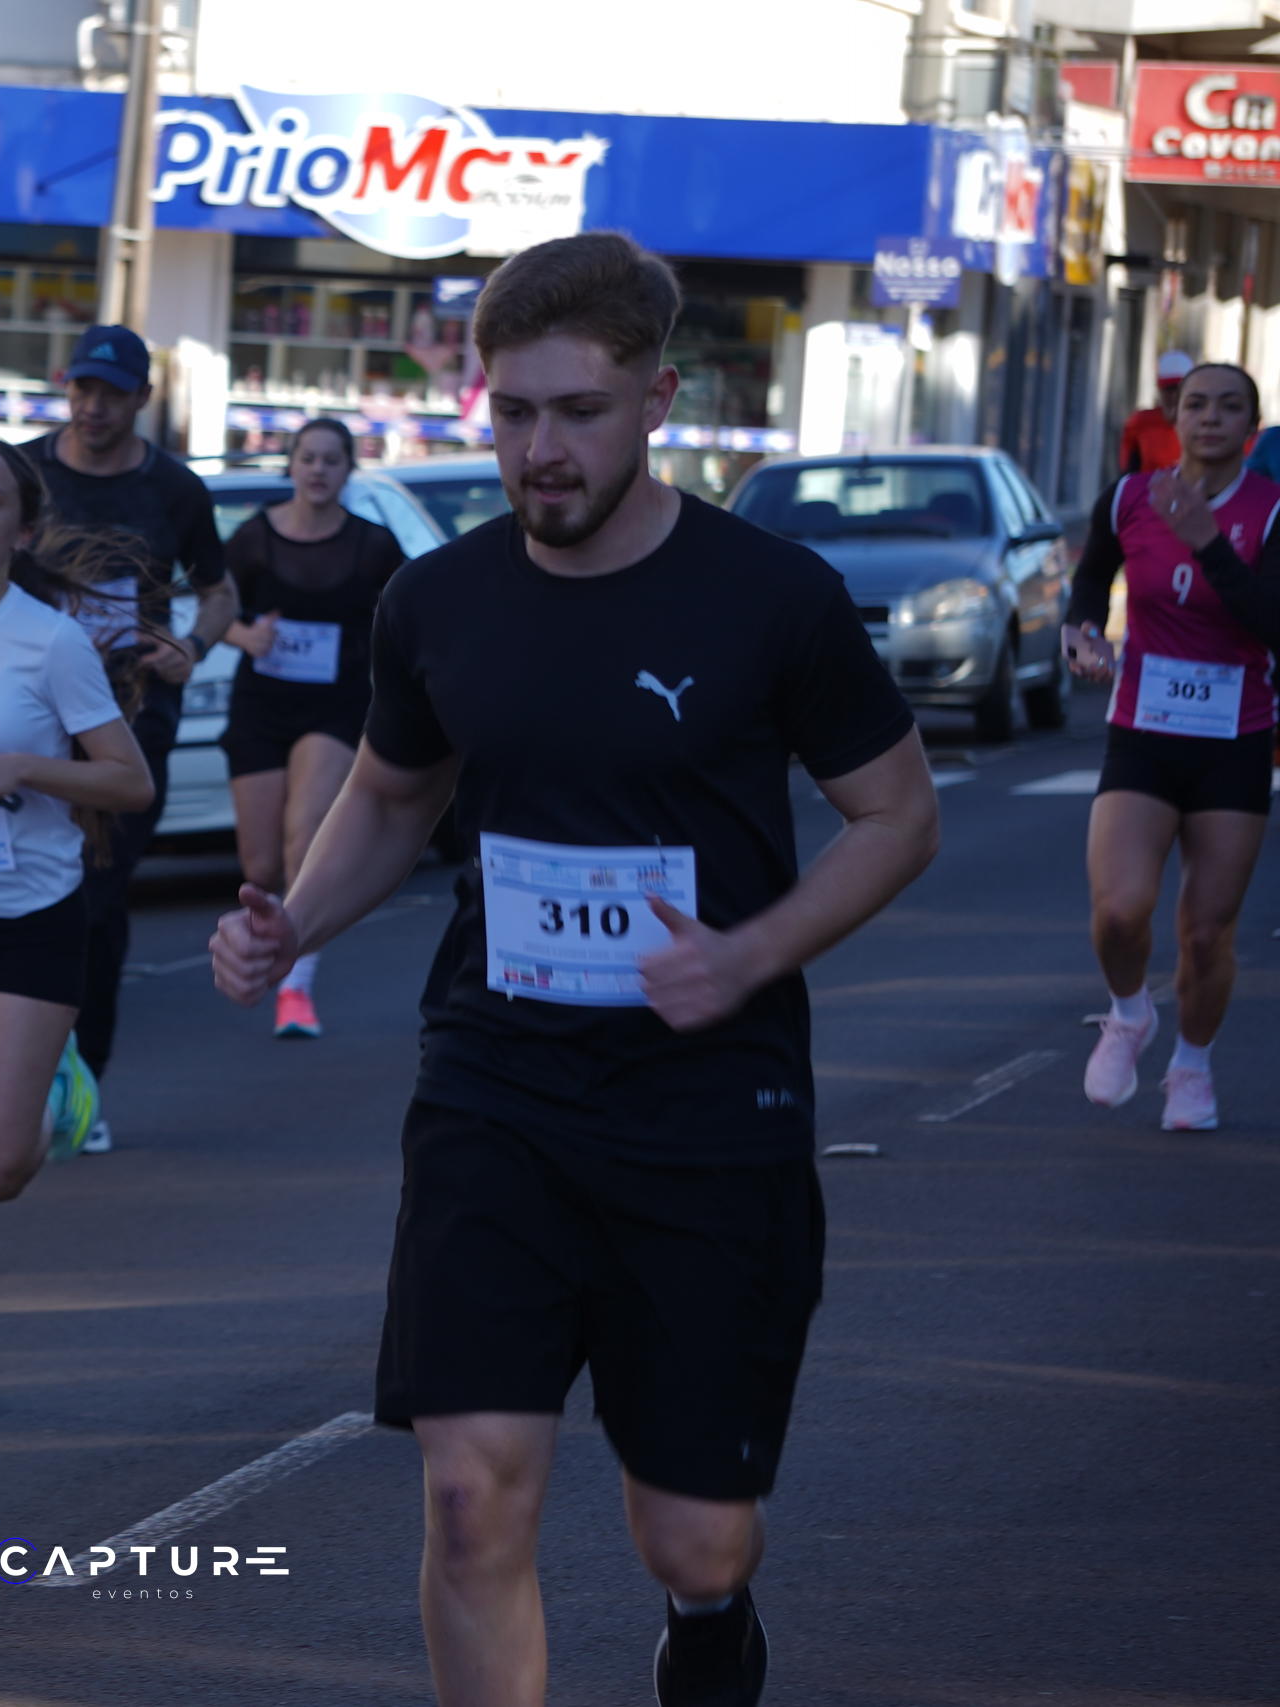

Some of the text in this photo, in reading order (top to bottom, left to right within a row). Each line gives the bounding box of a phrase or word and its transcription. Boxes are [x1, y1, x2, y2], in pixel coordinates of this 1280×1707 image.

[1172, 562, 1194, 606] 9
[1166, 680, 1211, 701] 303
[538, 896, 630, 940] 310
